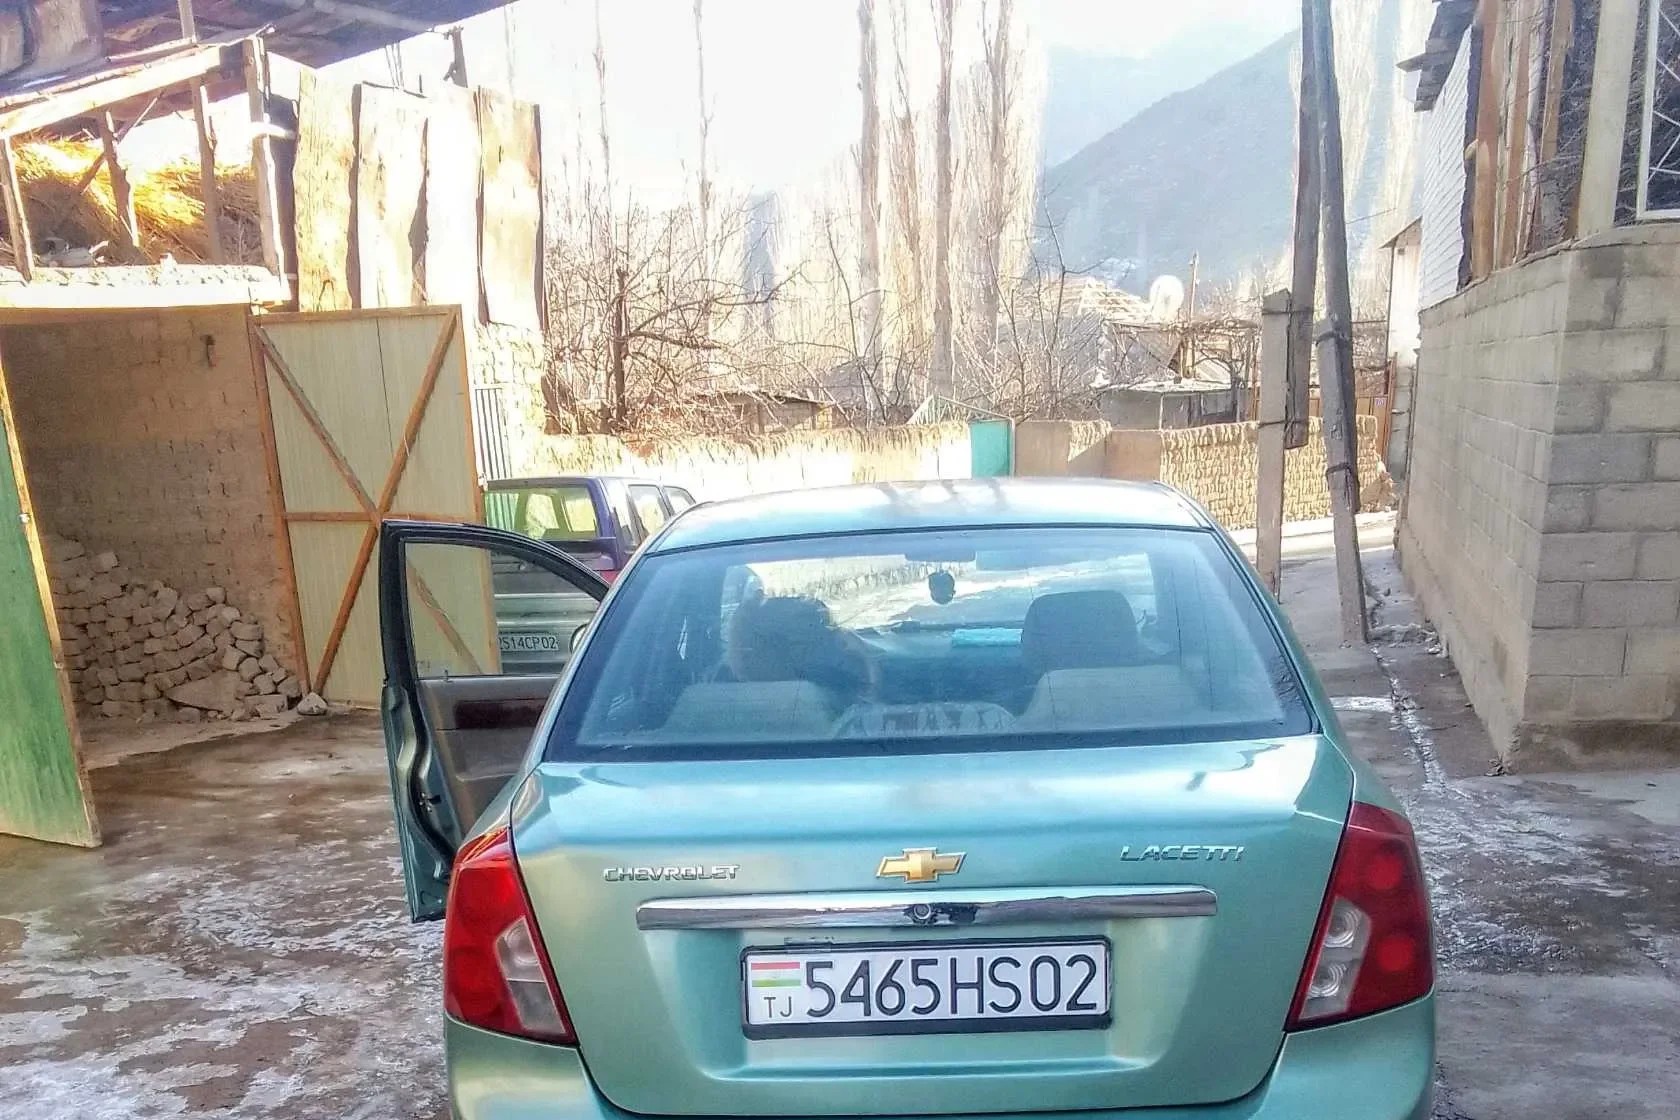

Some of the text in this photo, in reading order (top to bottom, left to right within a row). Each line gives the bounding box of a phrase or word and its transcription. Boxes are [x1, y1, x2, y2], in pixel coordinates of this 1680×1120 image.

[1120, 845, 1245, 862] LACETTI
[603, 864, 740, 882] CHEVROLET
[806, 954, 1098, 1017] 5465HS02
[763, 996, 793, 1018] TJ
